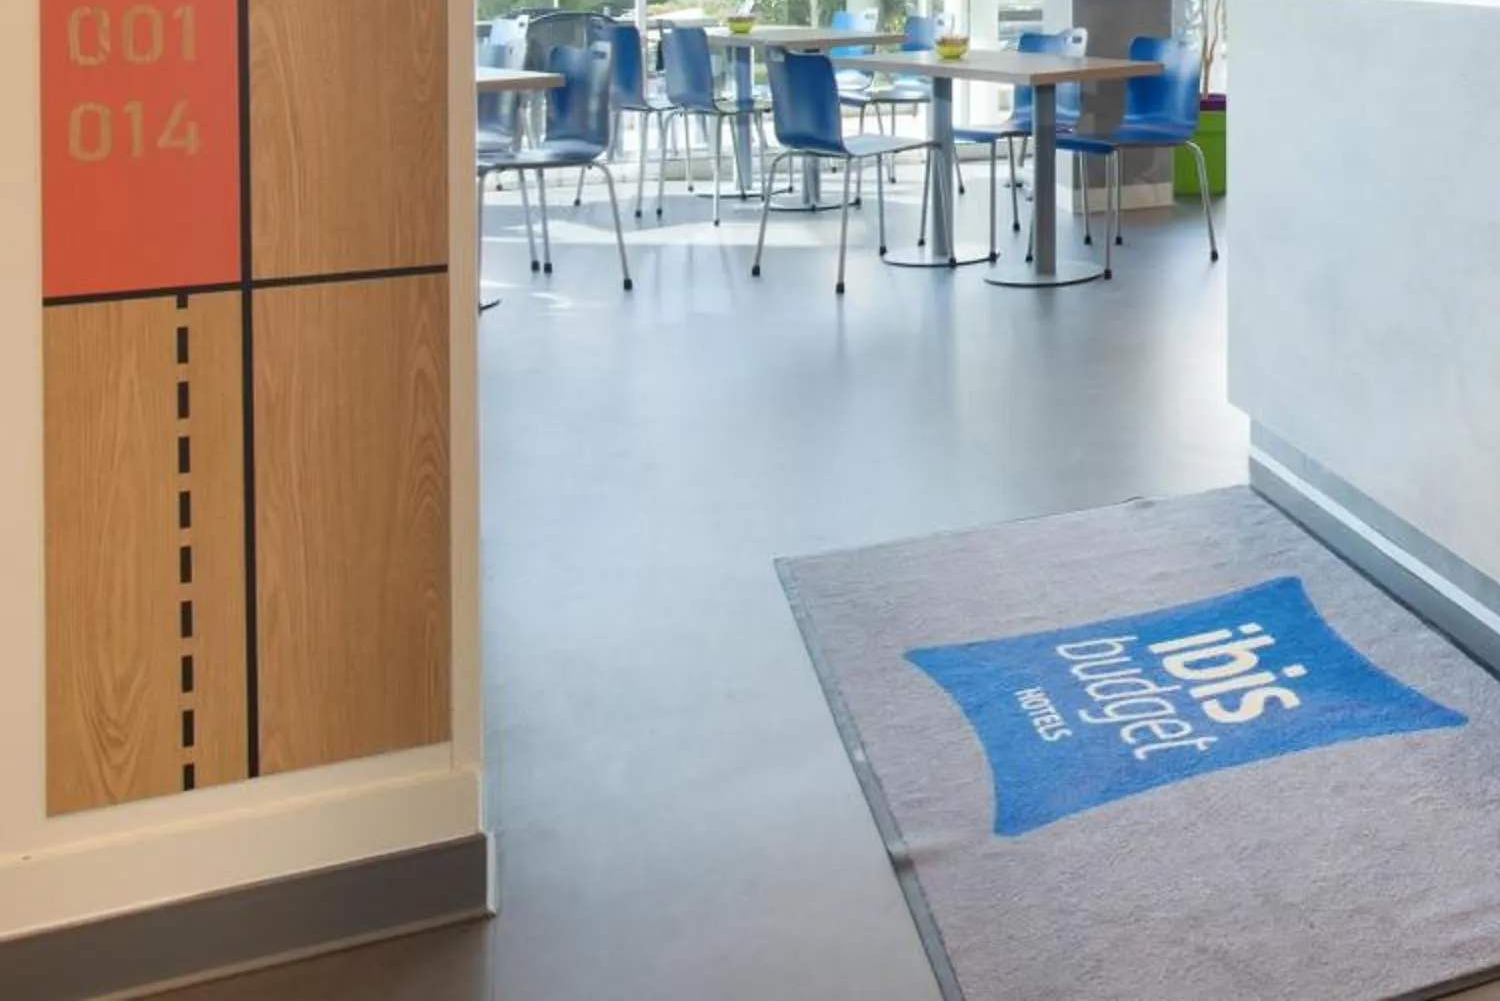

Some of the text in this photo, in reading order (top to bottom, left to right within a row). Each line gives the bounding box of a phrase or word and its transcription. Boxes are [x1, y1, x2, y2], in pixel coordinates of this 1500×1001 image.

[69, 5, 196, 66] 001
[69, 100, 201, 162] 014
[1056, 636, 1219, 760] budget
[1149, 623, 1308, 724] ibis
[1016, 686, 1073, 742] HOTELS
